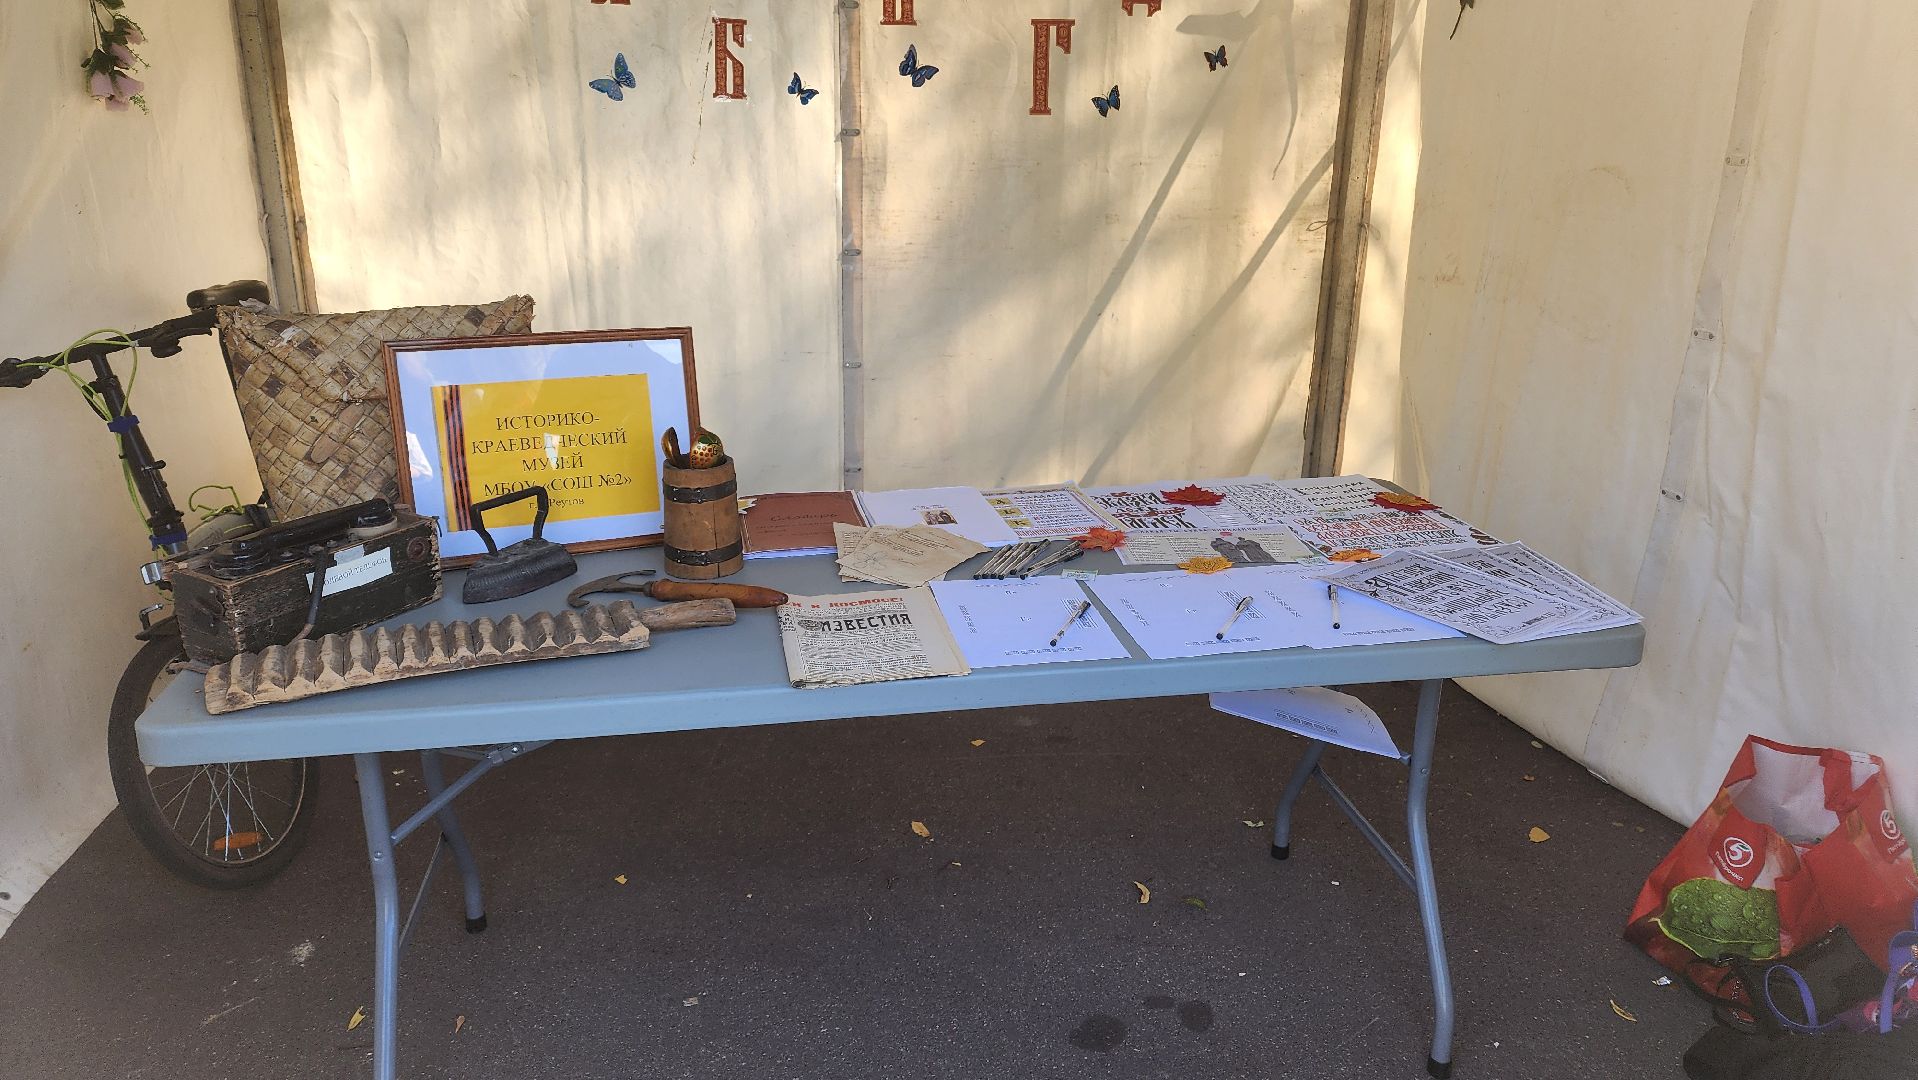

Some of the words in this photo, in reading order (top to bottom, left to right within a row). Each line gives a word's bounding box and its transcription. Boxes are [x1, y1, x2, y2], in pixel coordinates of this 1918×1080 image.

[712, 17, 747, 99] Б
[1029, 19, 1076, 115] Г
[496, 411, 600, 431] ИСТОРИКО-
[471, 428, 628, 454] КРАЕВЕДЧЕСКИЙ
[522, 452, 584, 472] МУЗЕЙ
[543, 475, 593, 491] «СОШ
[598, 473, 632, 487] №2»
[324, 568, 354, 586] ОЛЕВОЙ
[821, 613, 912, 632] ИЗВЕСТИЯ
[1727, 842, 1751, 861] 5
